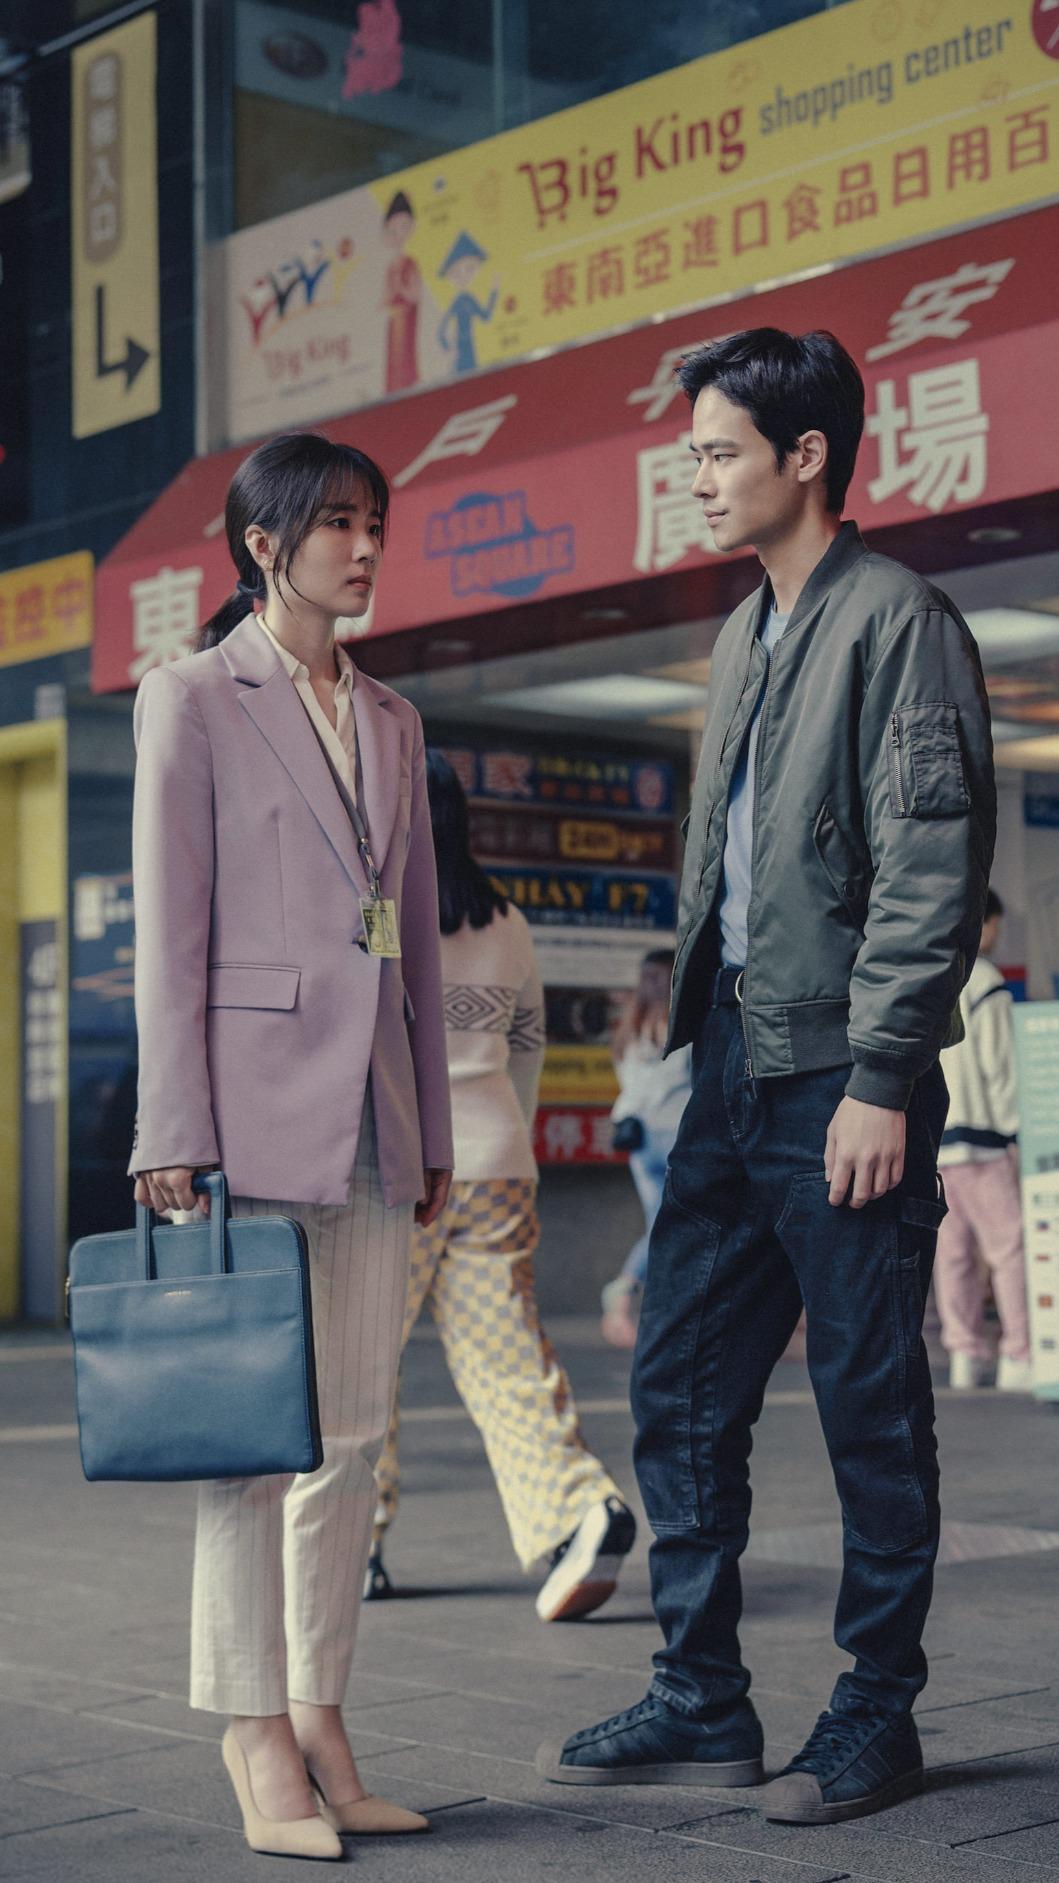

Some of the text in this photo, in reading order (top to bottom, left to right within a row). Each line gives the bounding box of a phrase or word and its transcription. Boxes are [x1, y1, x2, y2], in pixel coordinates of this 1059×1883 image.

[517, 149, 619, 229] Big
[633, 106, 746, 180] King
[758, 60, 894, 135] shopping
[904, 17, 1013, 85] center
[542, 104, 1050, 316] 東南亞進口食品日用百
